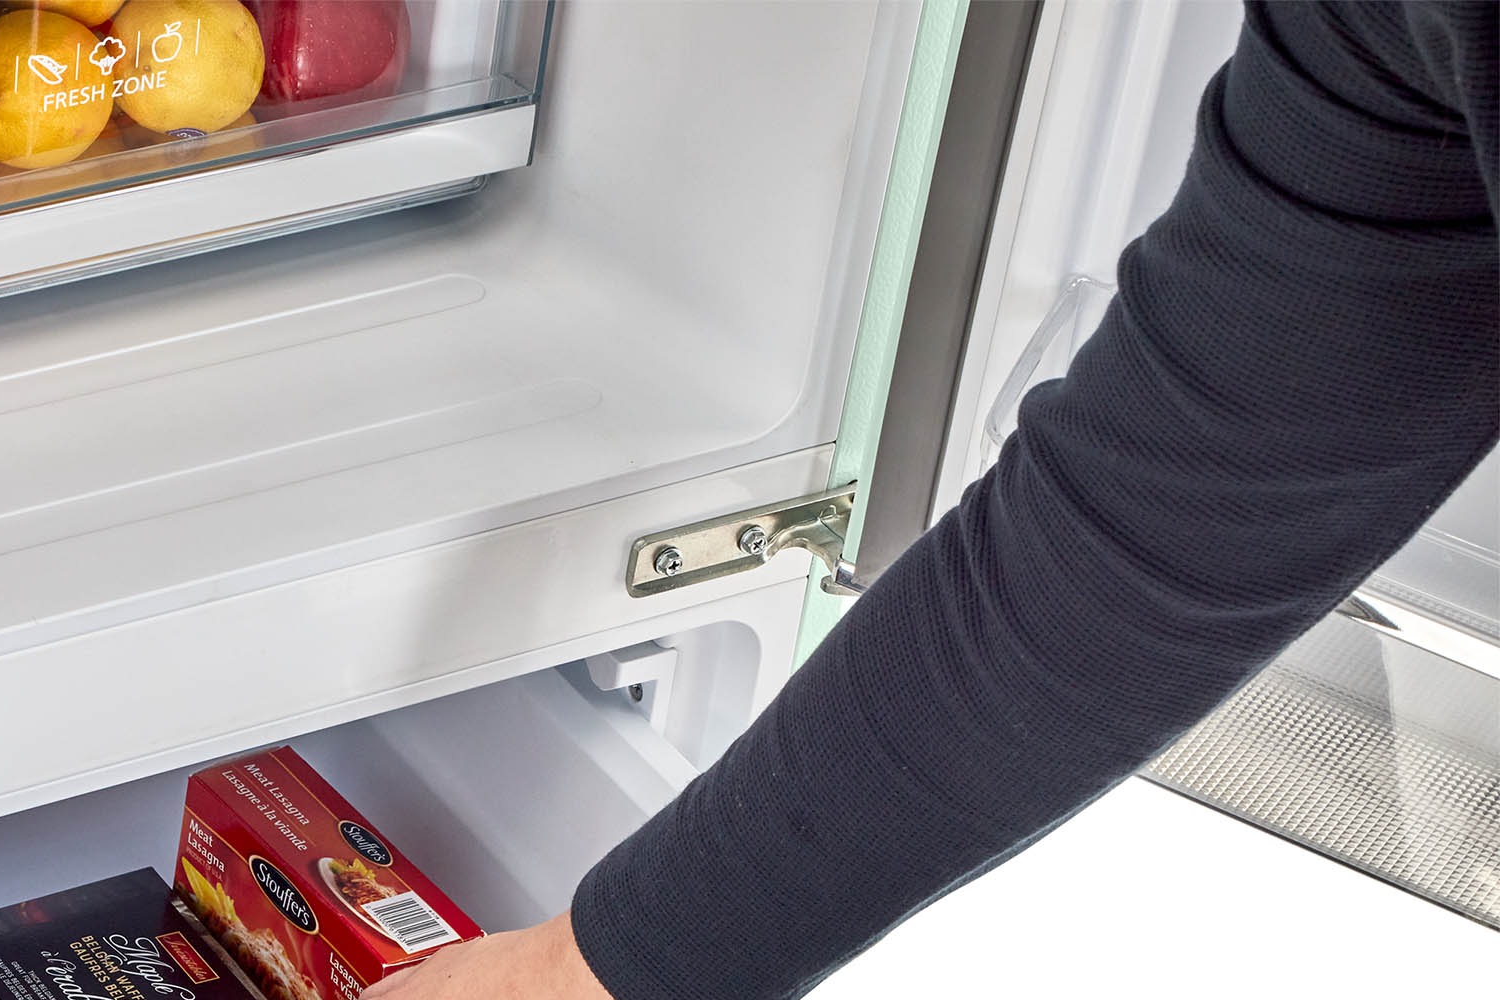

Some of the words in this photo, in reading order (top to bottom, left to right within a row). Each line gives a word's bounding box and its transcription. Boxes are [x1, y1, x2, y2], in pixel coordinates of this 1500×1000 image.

[43, 83, 106, 112] FRESH
[111, 70, 167, 98] ZONE
[222, 770, 260, 804] Lasagne
[264, 810, 276, 820] la
[274, 820, 308, 851] viande
[244, 763, 274, 787] Meat
[269, 787, 310, 825] Lasagna
[188, 832, 225, 872] Lasagna
[190, 819, 213, 848] Meat
[343, 826, 386, 862] Stouffer's
[257, 863, 310, 926] Stouffer's
[69, 941, 111, 983] GAUFRES
[81, 935, 122, 974] BELGIAN
[103, 934, 196, 1000] Maple
[330, 952, 364, 994] Lasagne
[331, 967, 339, 986] la
